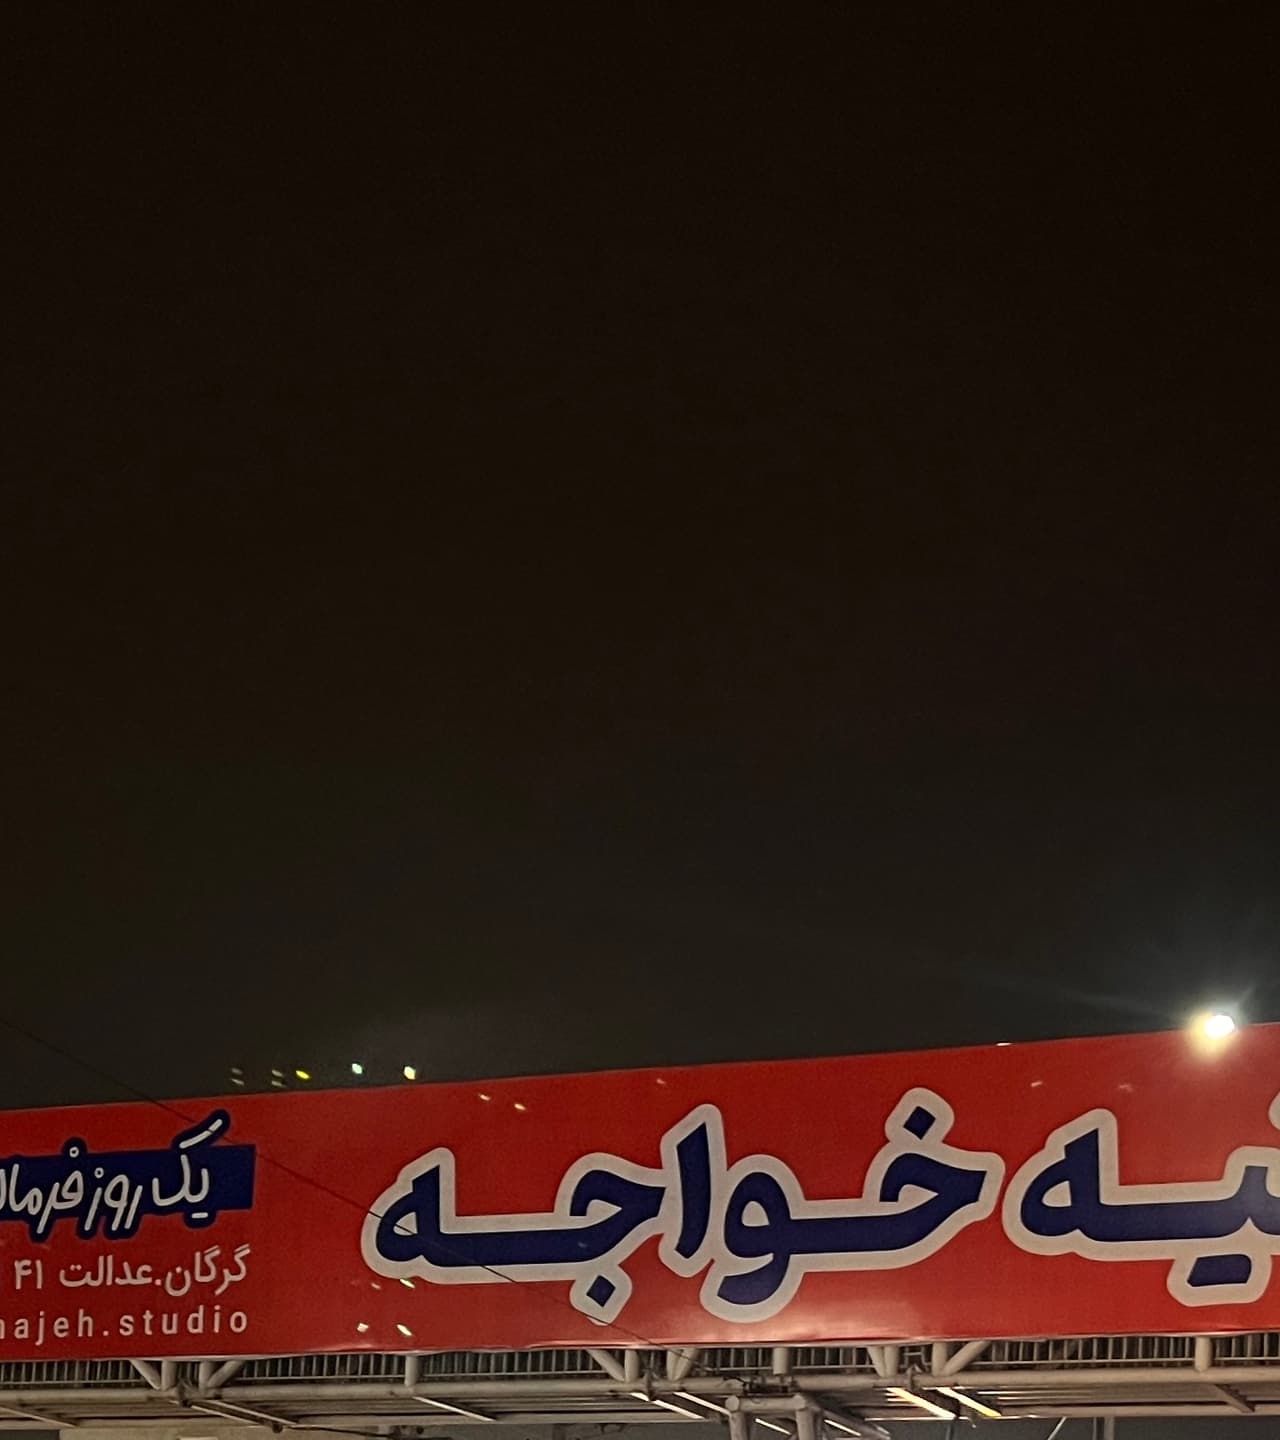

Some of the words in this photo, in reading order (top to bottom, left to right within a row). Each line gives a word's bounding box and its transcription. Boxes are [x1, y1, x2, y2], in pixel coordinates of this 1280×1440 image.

[83, 1166, 144, 1232] روز
[151, 1117, 224, 1220] یک
[361, 1087, 1003, 1325] خواجه
